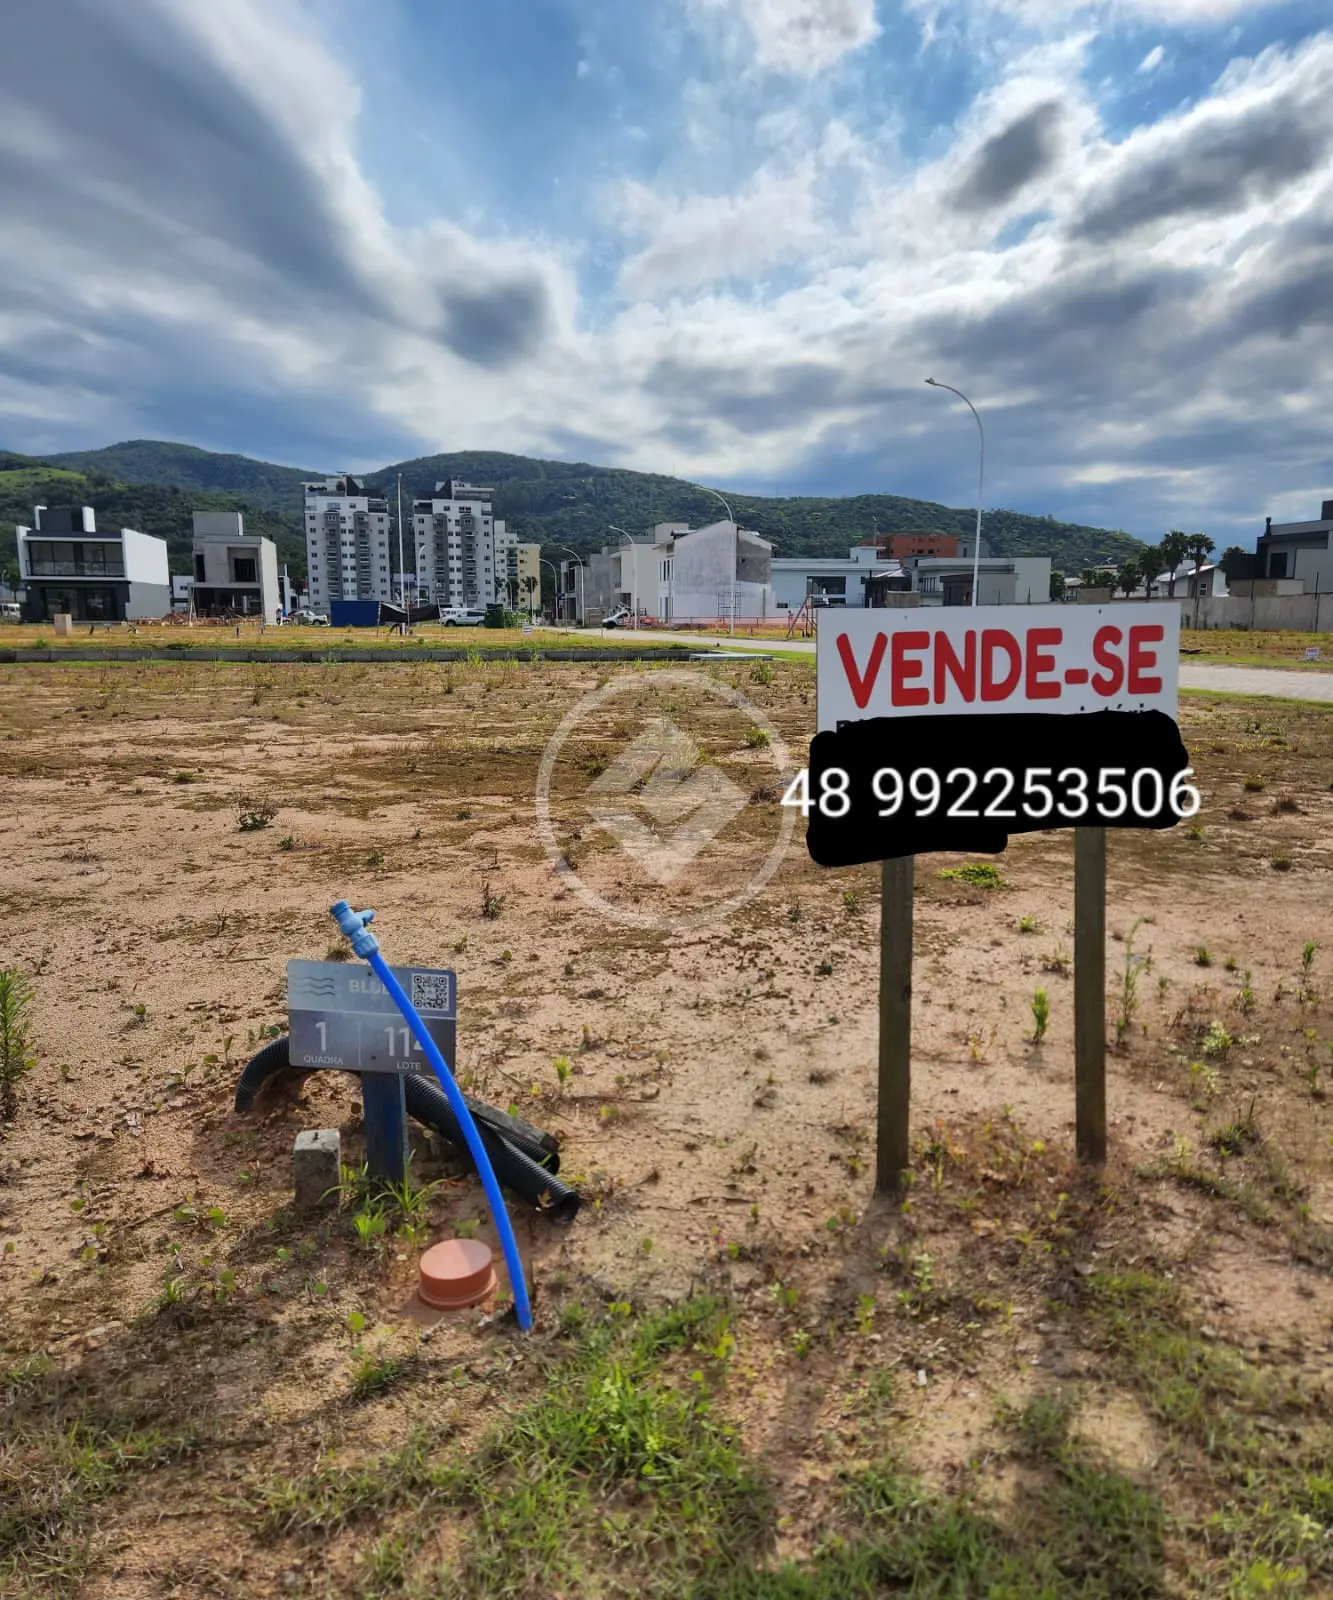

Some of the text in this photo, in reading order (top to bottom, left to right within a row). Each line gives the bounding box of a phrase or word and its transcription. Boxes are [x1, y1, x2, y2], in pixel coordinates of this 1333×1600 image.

[836, 624, 1164, 709] VENDE-SE
[315, 1021, 327, 1051] 1
[384, 1026, 424, 1058] 11
[303, 1054, 344, 1066] QUADRA
[397, 1062, 421, 1071] LOTE
